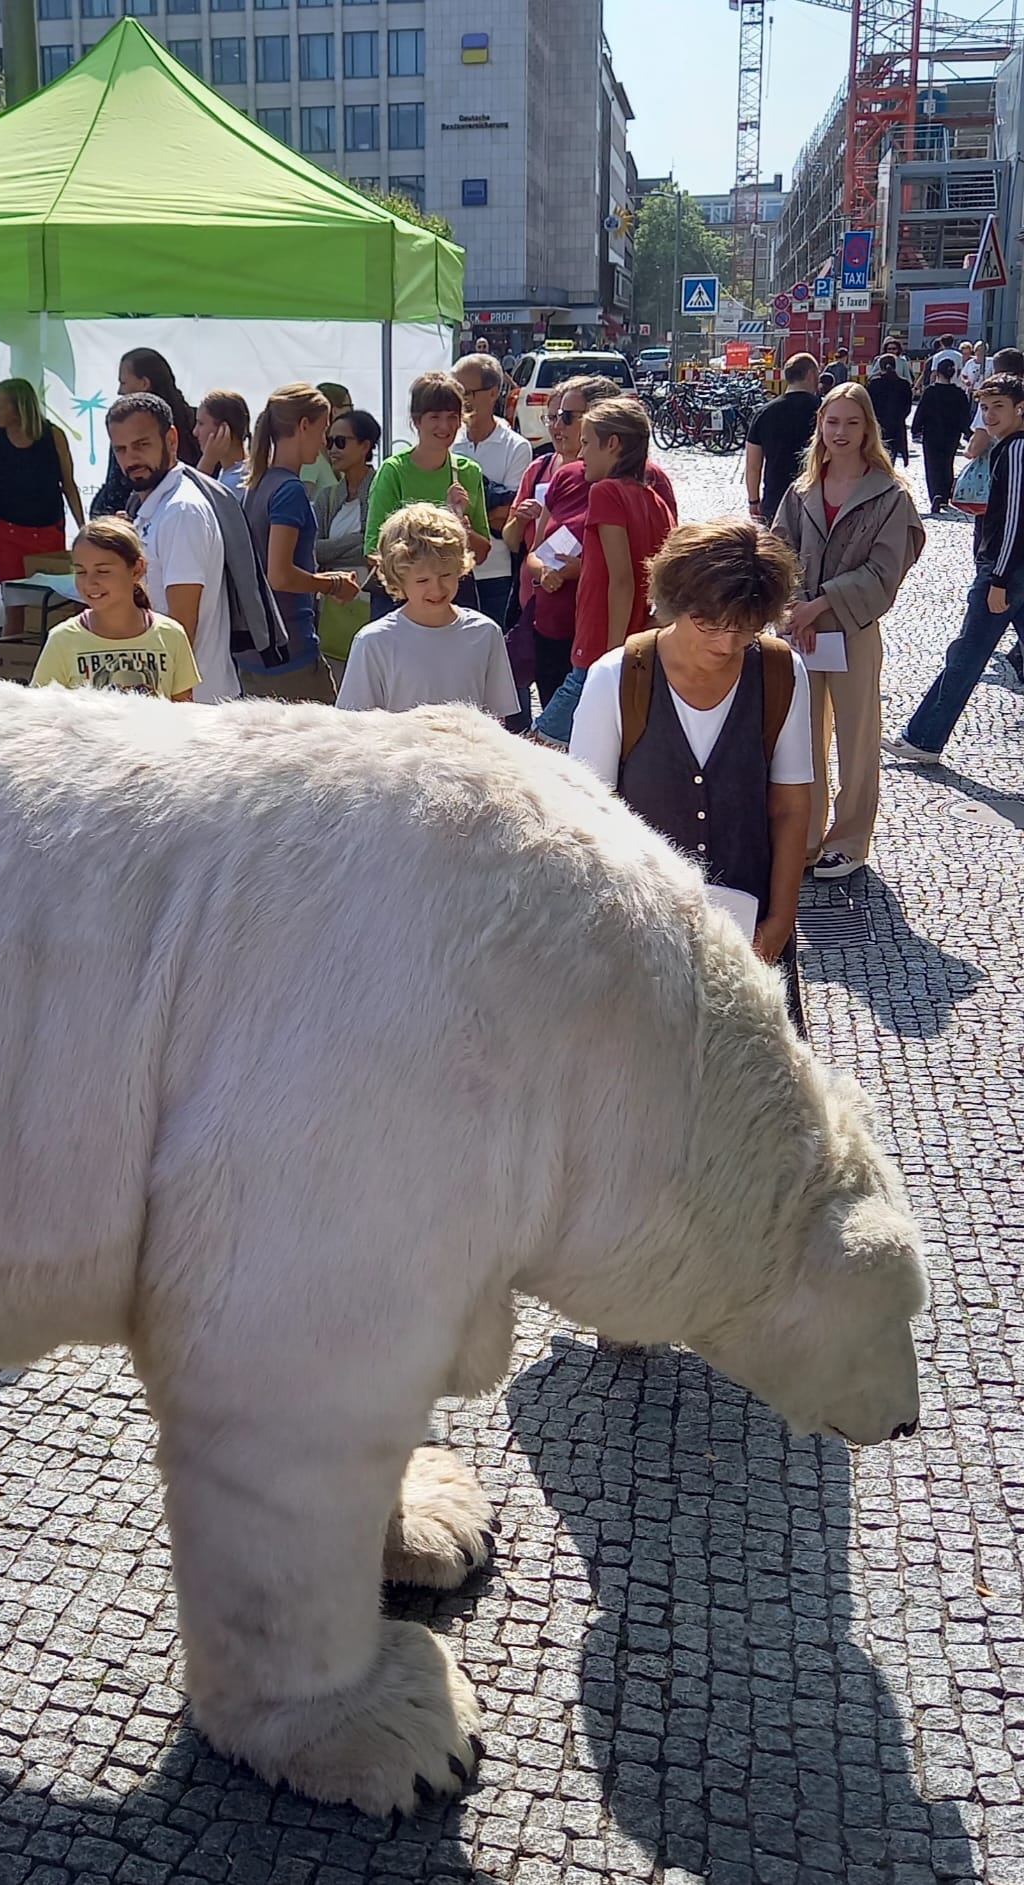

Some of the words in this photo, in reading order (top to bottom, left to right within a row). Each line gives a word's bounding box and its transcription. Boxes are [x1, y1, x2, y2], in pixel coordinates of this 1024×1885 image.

[844, 272, 865, 285] TAXI
[817, 281, 827, 295] P
[839, 297, 845, 307] 5
[846, 296, 868, 307] Taxen
[490, 312, 514, 321] PROFI
[77, 653, 167, 674] OBSCURE
